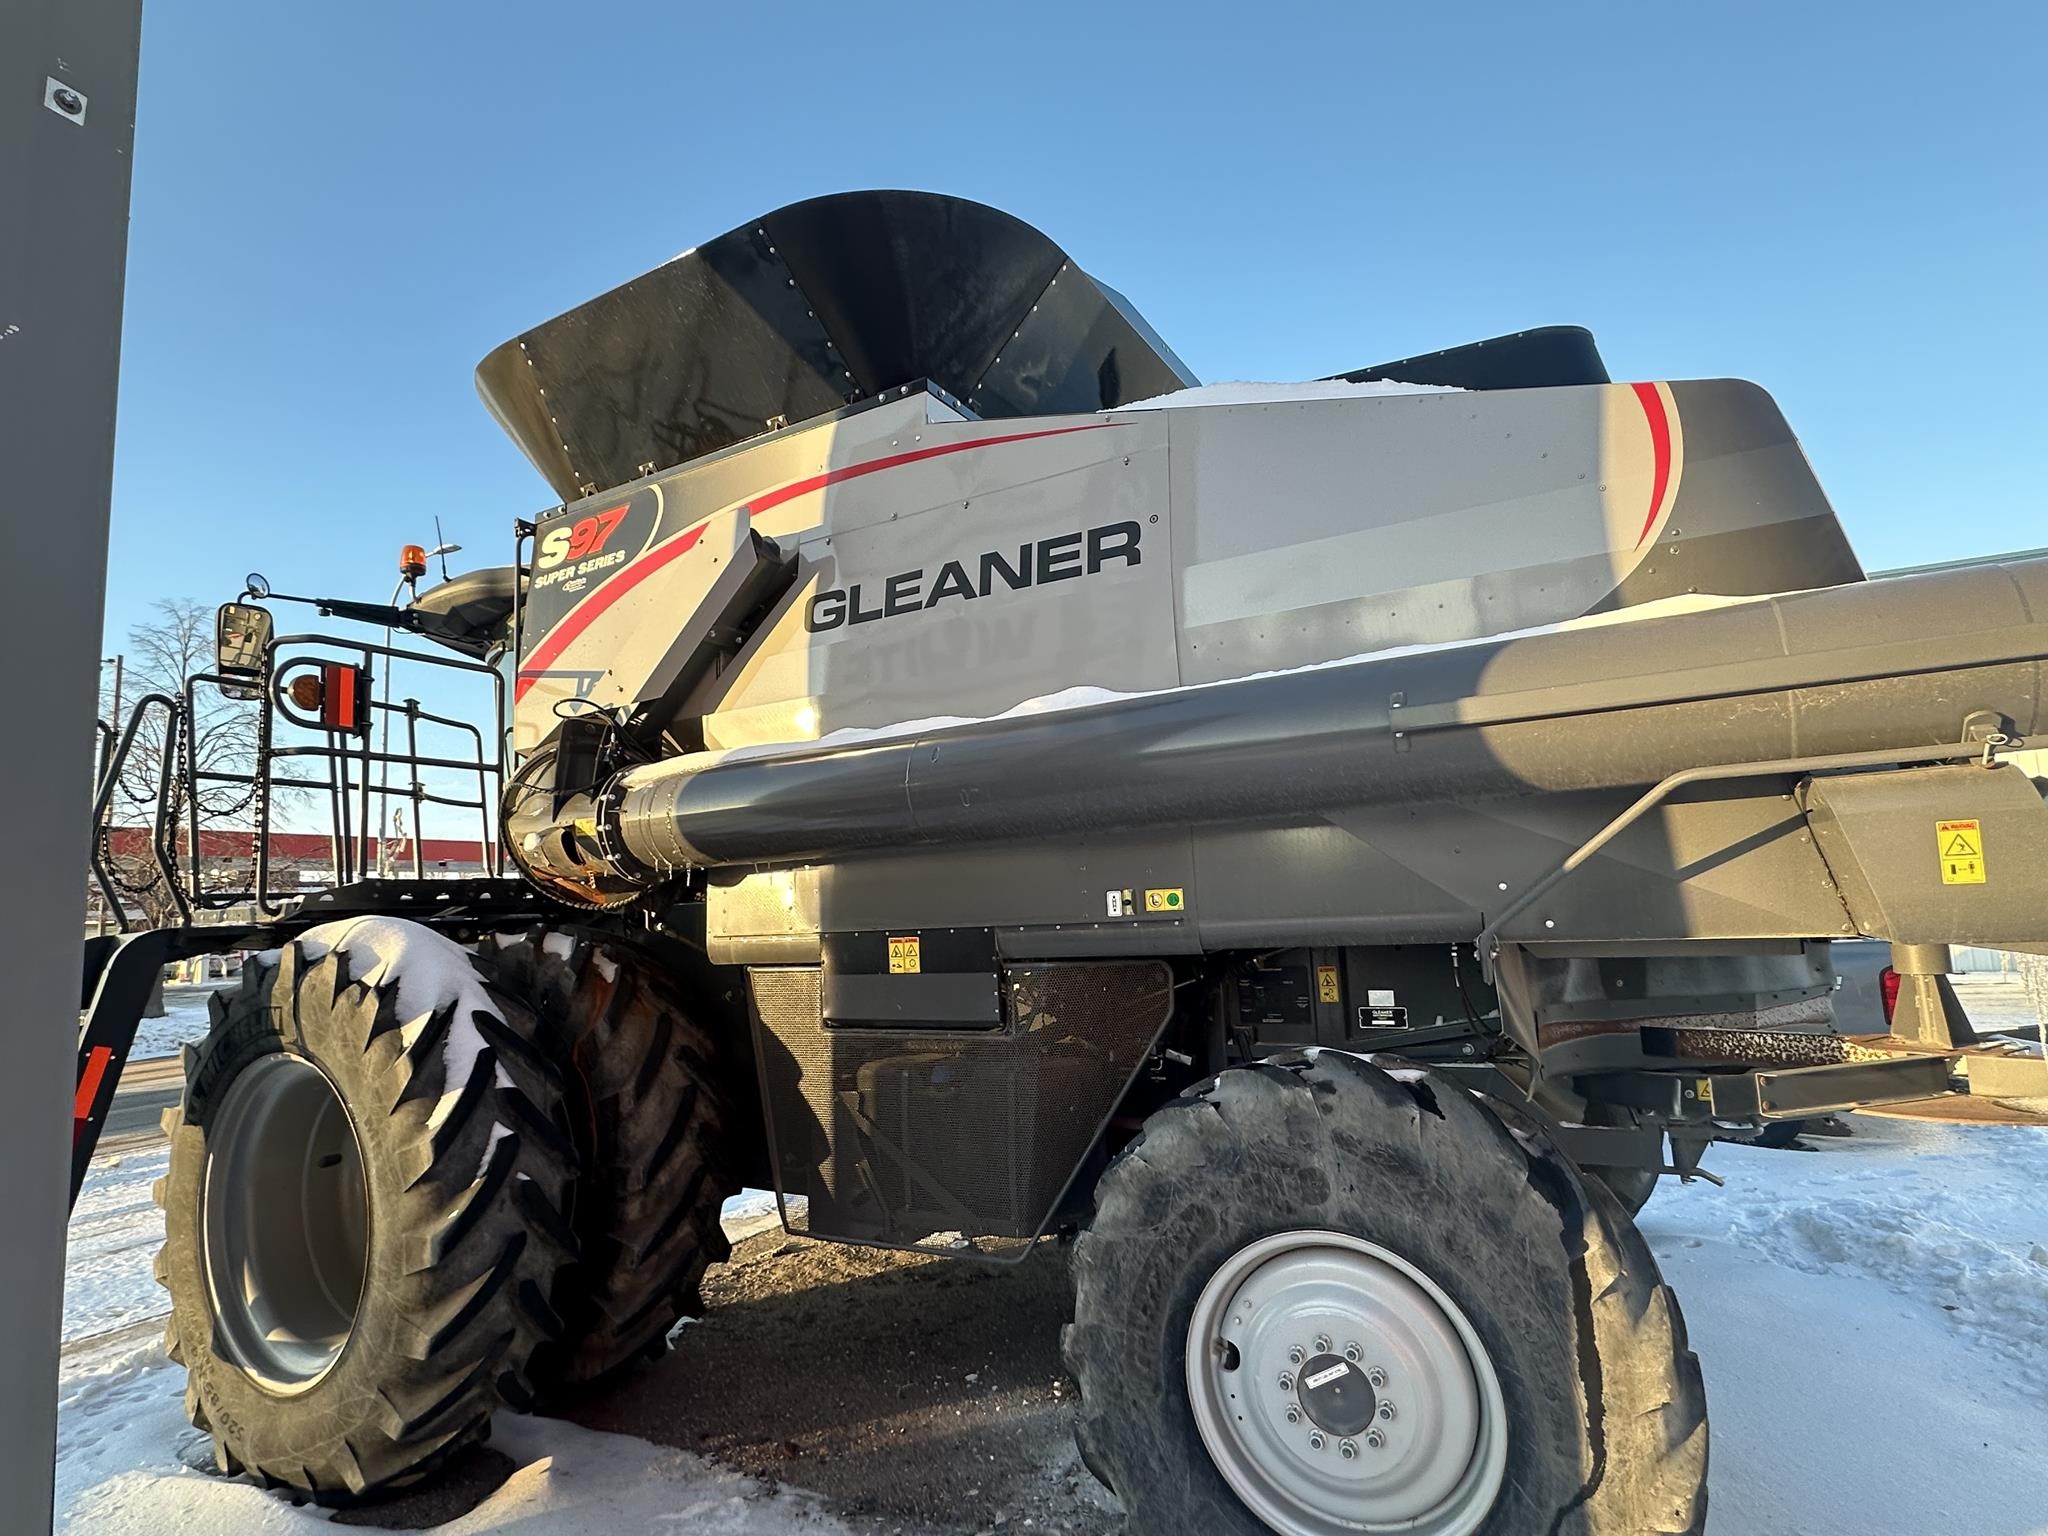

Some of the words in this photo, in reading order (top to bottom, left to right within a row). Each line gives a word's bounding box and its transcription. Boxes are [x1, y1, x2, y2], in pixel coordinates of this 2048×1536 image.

[538, 502, 632, 569] S97
[534, 566, 576, 589] SUPER
[577, 550, 626, 575] SERIES
[804, 520, 1142, 633] GLEANER
